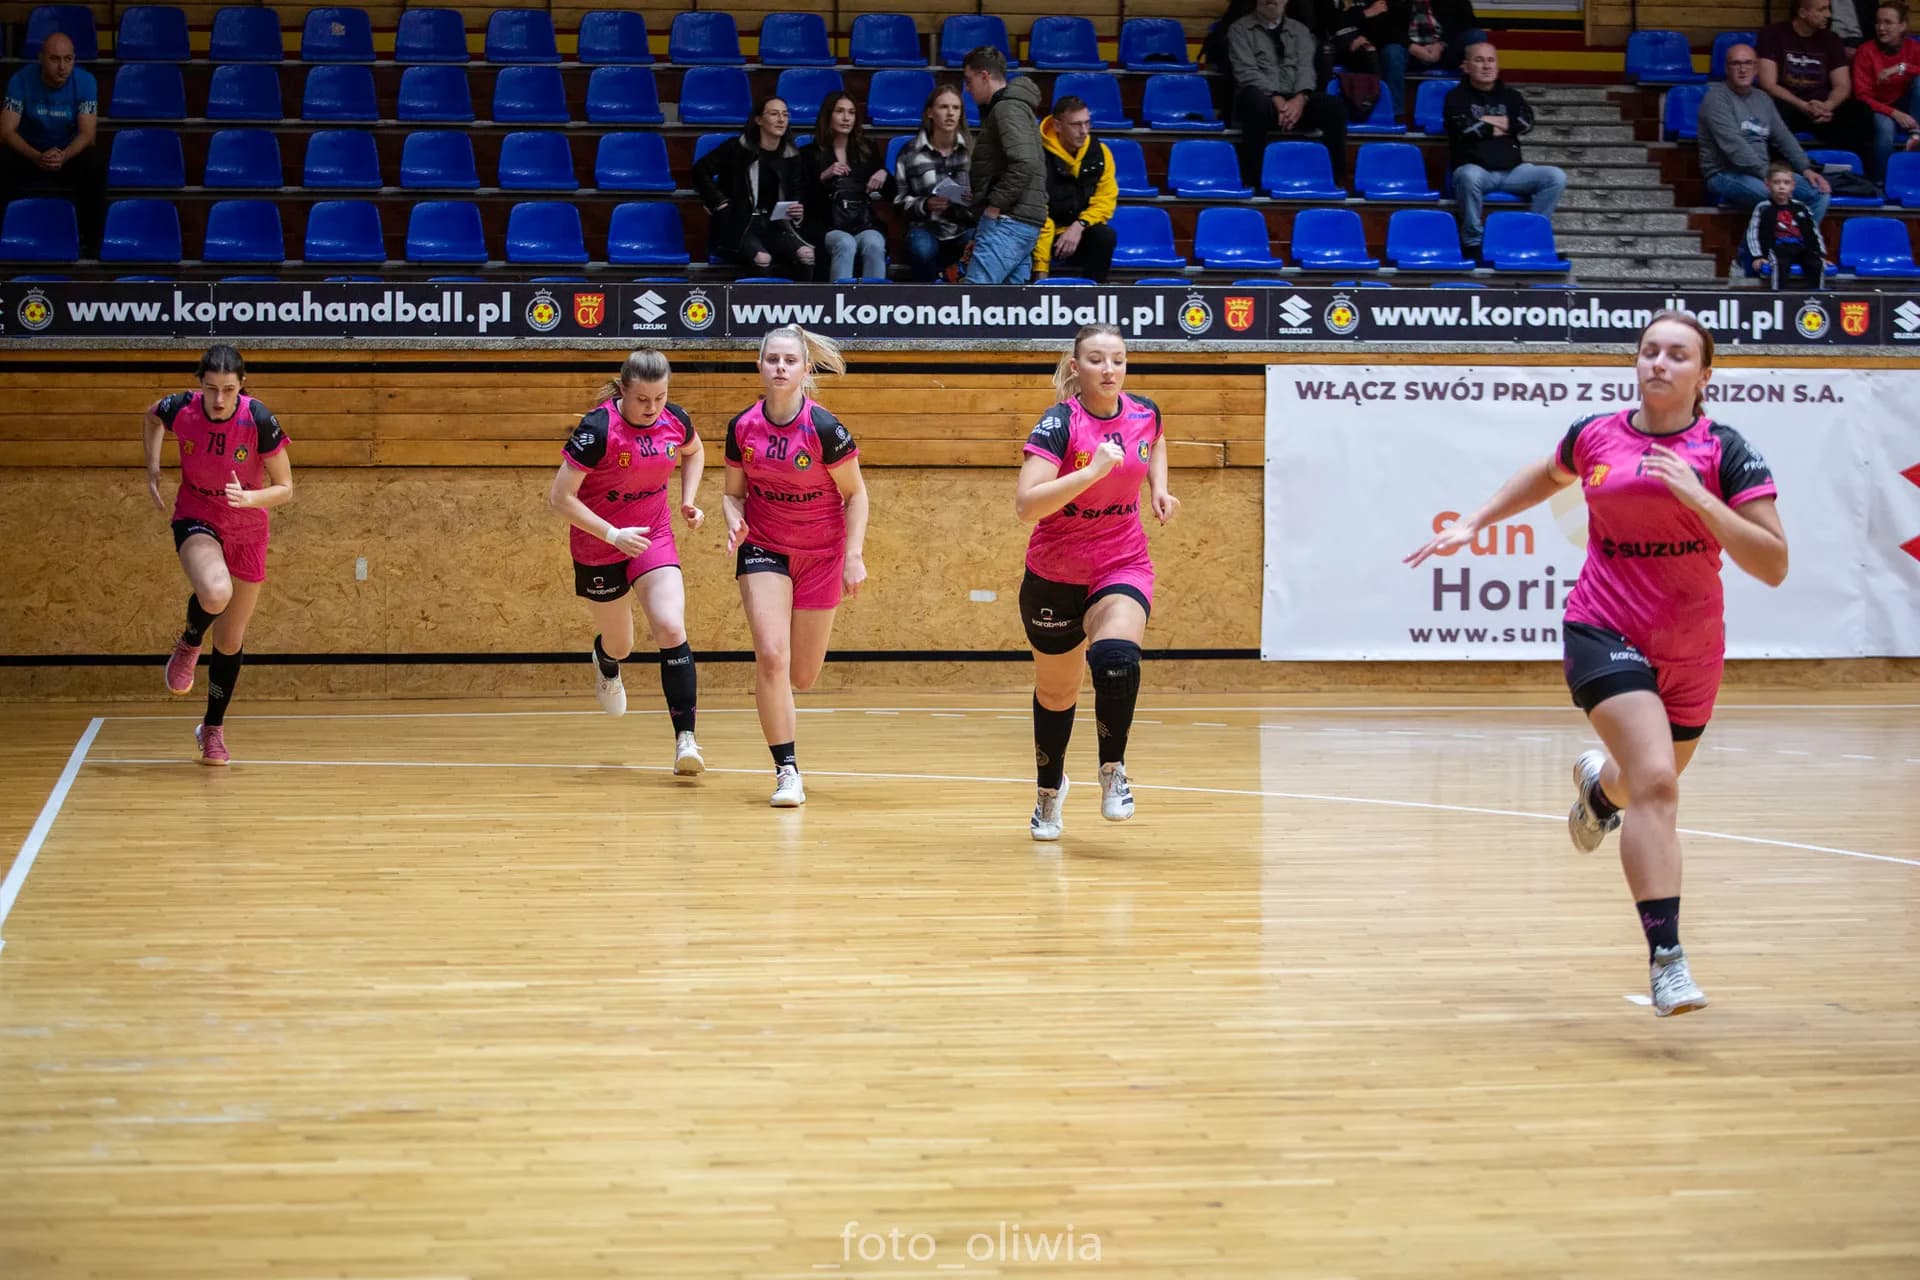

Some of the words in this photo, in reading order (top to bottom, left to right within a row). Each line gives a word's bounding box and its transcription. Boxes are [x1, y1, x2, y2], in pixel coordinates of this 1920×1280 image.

[67, 291, 511, 333] www.koronahandball.pl
[577, 308, 599, 324] CK
[732, 293, 1164, 336] www.koronahandball.pl
[1227, 311, 1248, 327] CK
[1843, 316, 1864, 332] CK
[1295, 381, 1397, 406] WŁĄCZ
[1404, 377, 1485, 401] SWÓJ
[1493, 383, 1568, 407] PRĄD
[1577, 383, 1593, 401] Z
[1601, 384, 1642, 402] SU
[1704, 384, 1785, 402] RIZON
[1793, 384, 1845, 403] S.A.
[208, 432, 226, 456] 79
[636, 436, 659, 457] 32
[766, 435, 788, 460] 20
[1432, 511, 1535, 556] Sun
